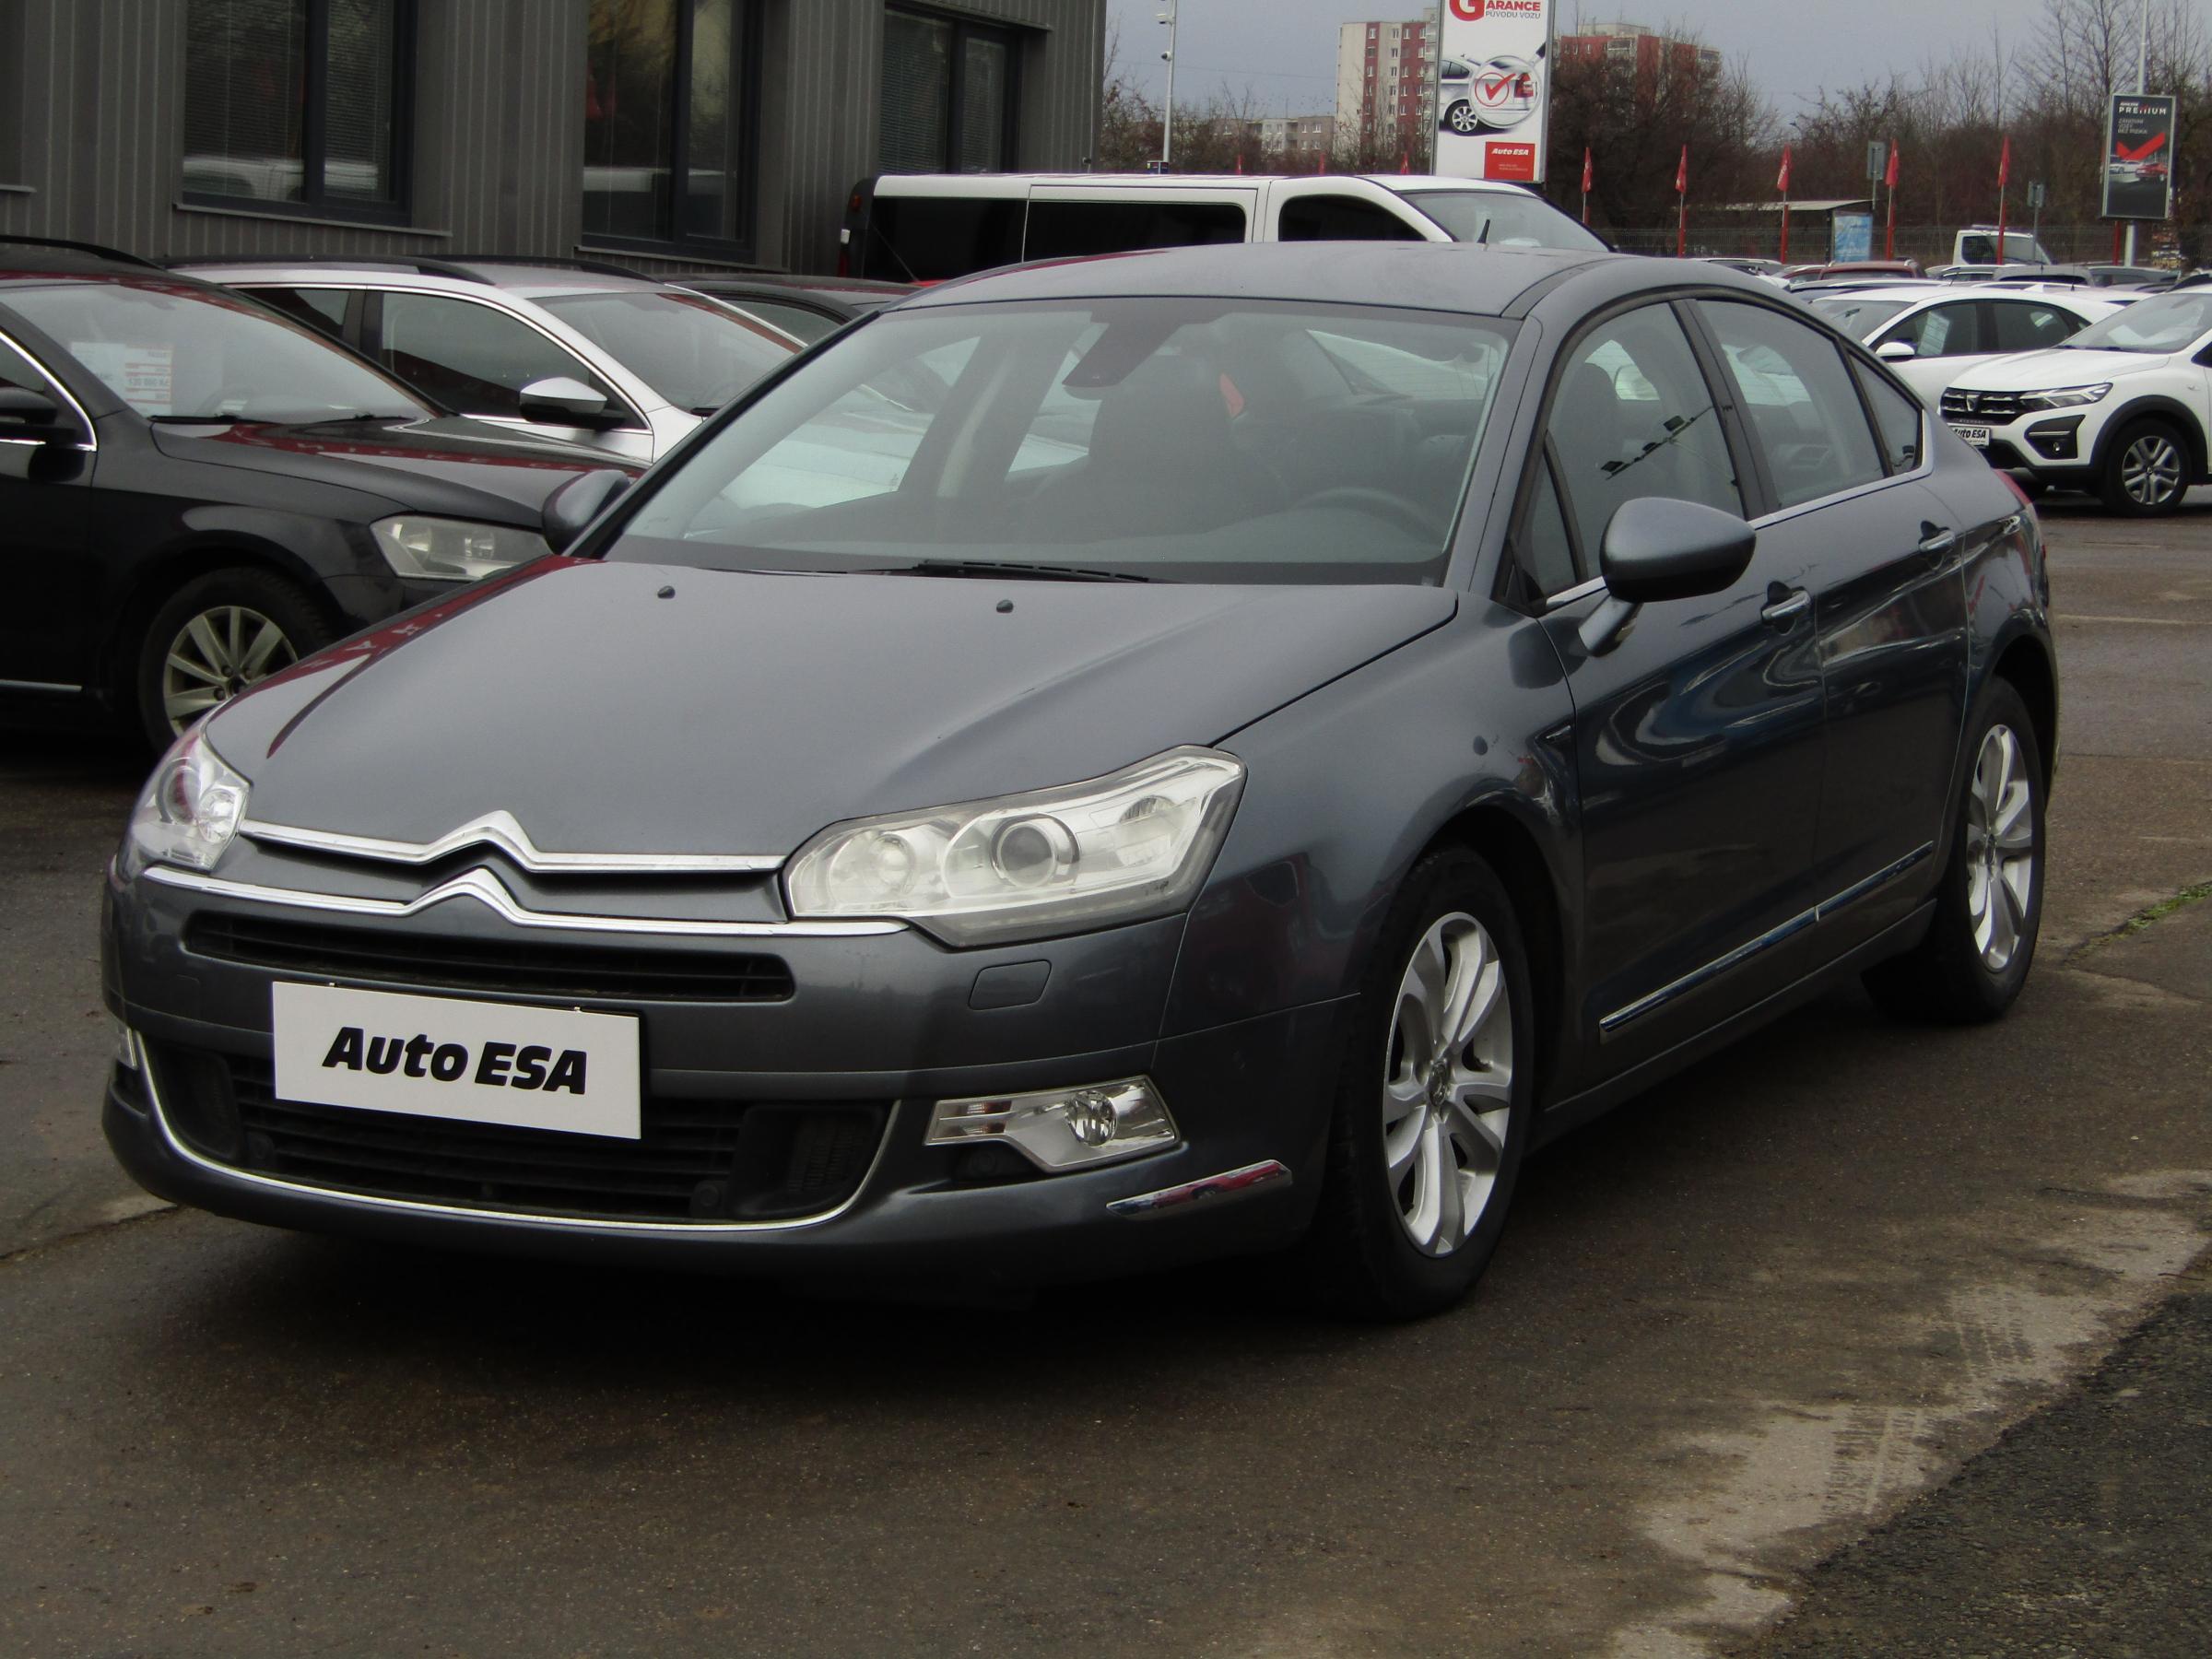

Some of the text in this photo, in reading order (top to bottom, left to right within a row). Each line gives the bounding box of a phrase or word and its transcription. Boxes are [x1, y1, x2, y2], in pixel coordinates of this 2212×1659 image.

[1449, 0, 1541, 21] GARANCE
[1519, 11, 1541, 19] VOZU
[1971, 429, 1986, 439] ESA
[322, 1027, 587, 1095] Auto ESA
